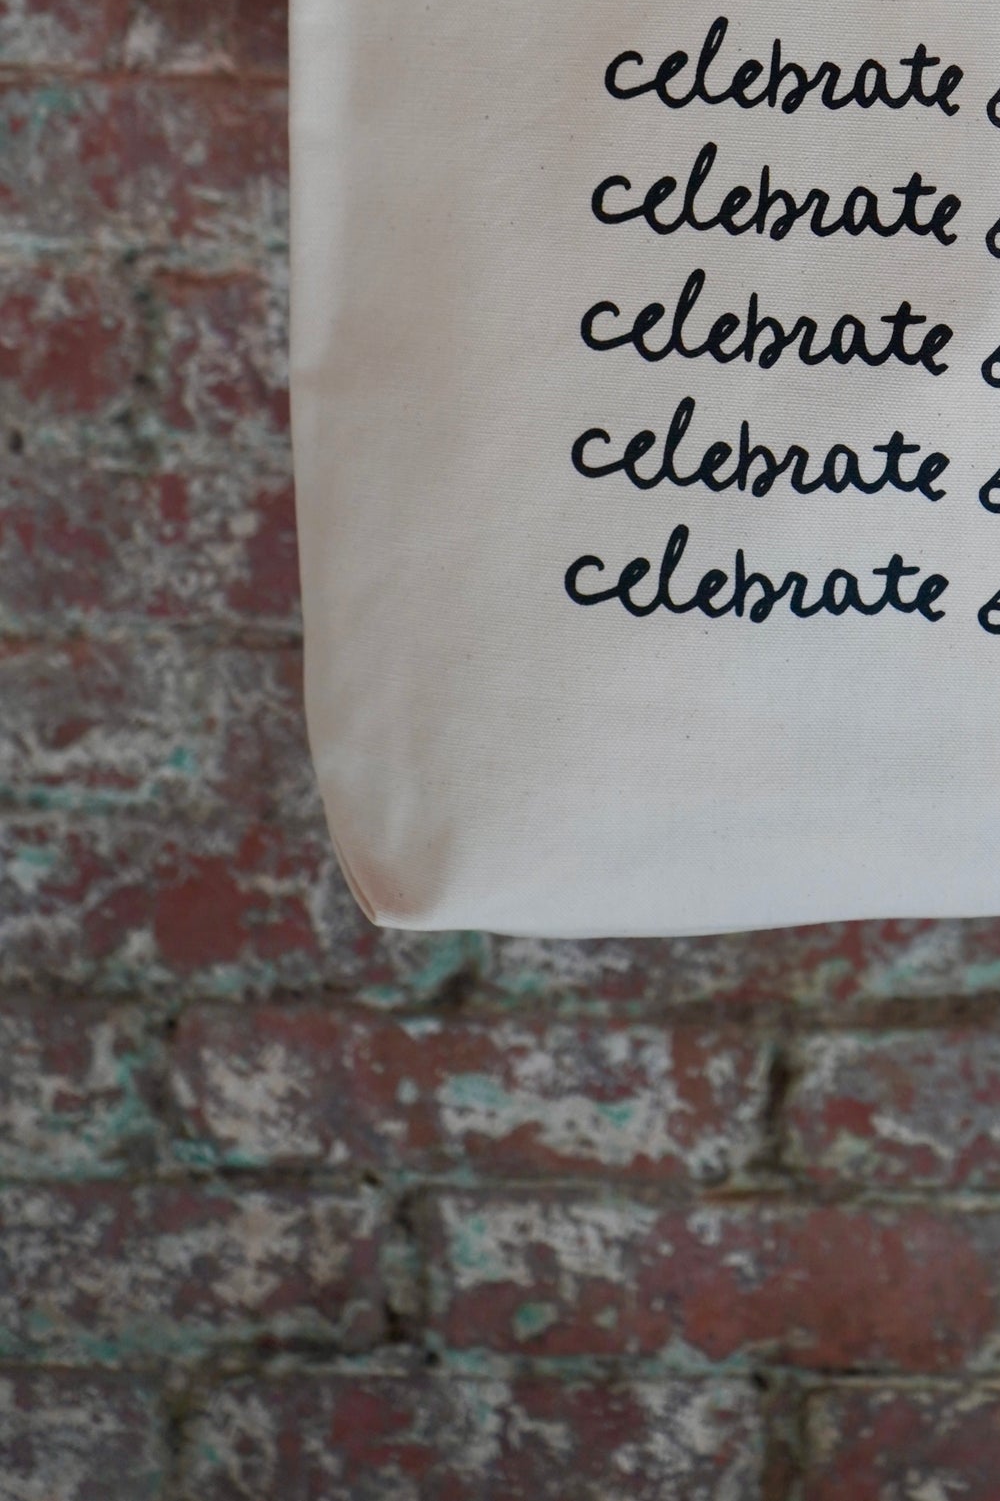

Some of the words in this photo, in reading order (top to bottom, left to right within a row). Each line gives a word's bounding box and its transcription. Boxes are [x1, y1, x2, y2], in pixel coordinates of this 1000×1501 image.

[604, 15, 964, 117] celebrate
[590, 141, 962, 247] celebrate
[580, 268, 954, 377] celebrate
[570, 395, 951, 502] celebrate
[563, 523, 950, 624] celebrate
